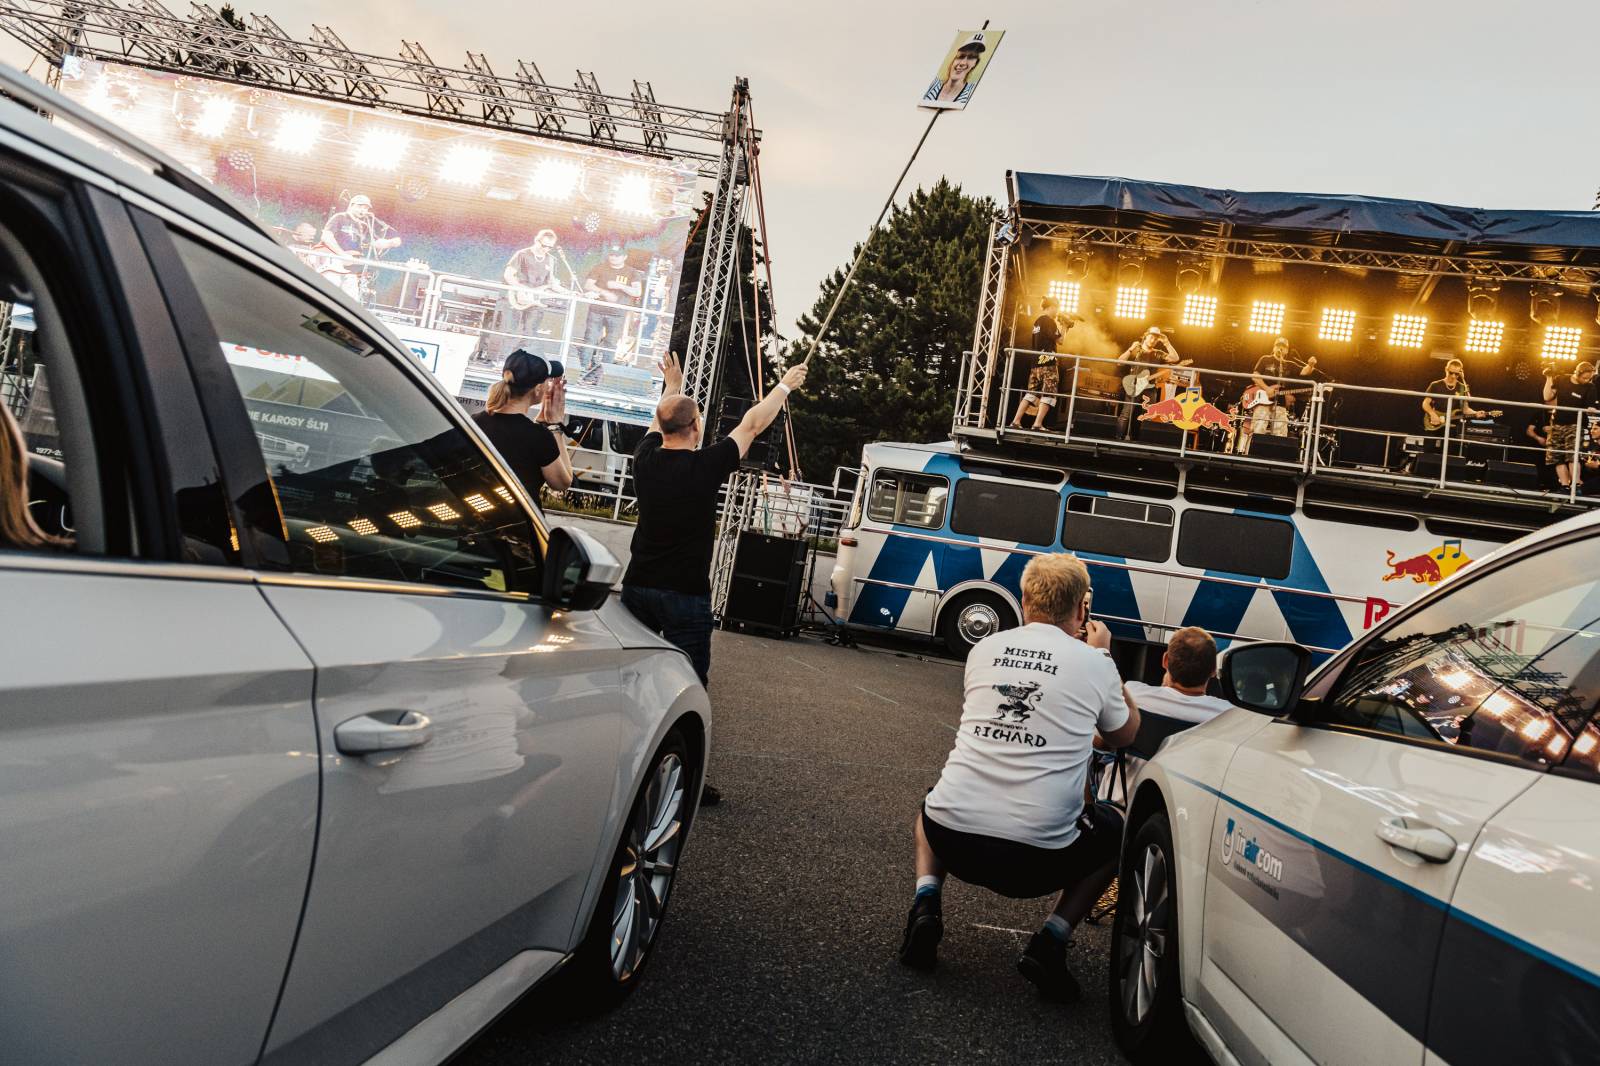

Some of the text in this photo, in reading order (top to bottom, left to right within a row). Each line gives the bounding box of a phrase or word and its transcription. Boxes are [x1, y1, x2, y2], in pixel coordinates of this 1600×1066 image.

[261, 412, 305, 427] KAROSY
[1003, 646, 1053, 661] MISTŘI
[992, 657, 1059, 676] PŘICHÁZÍ
[973, 725, 1047, 747] RICHARD
